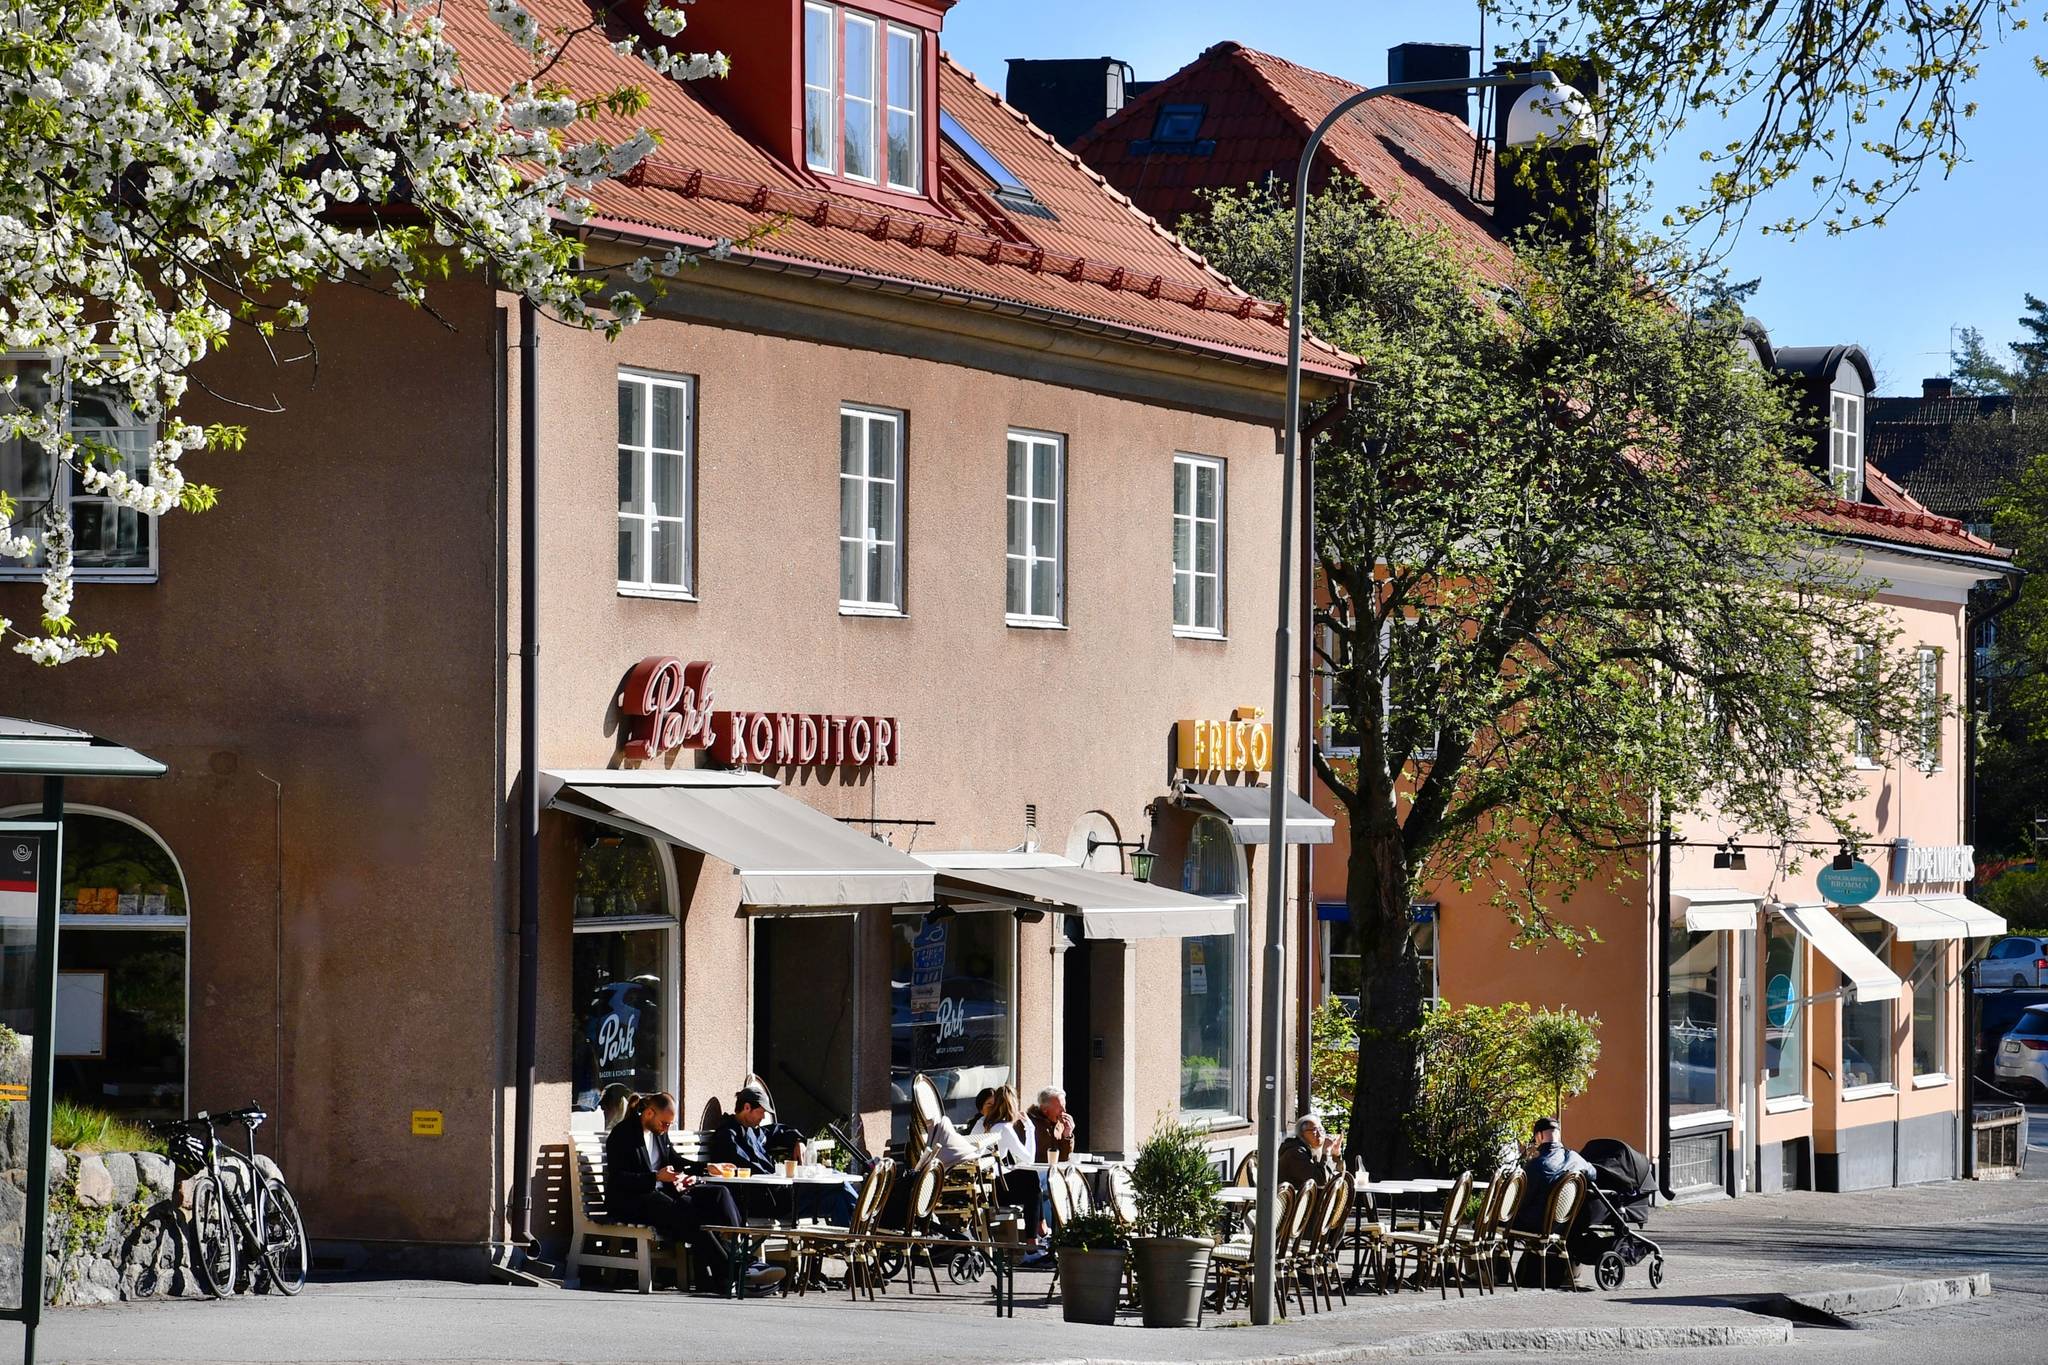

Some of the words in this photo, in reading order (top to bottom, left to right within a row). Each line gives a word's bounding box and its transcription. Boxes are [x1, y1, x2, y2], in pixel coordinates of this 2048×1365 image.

[640, 656, 716, 760] Park
[730, 711, 900, 766] KONDITORI
[1193, 706, 1273, 772] FRISÖ
[1831, 880, 1867, 889] BROMMA
[598, 1014, 635, 1067] Park
[935, 996, 965, 1043] Park
